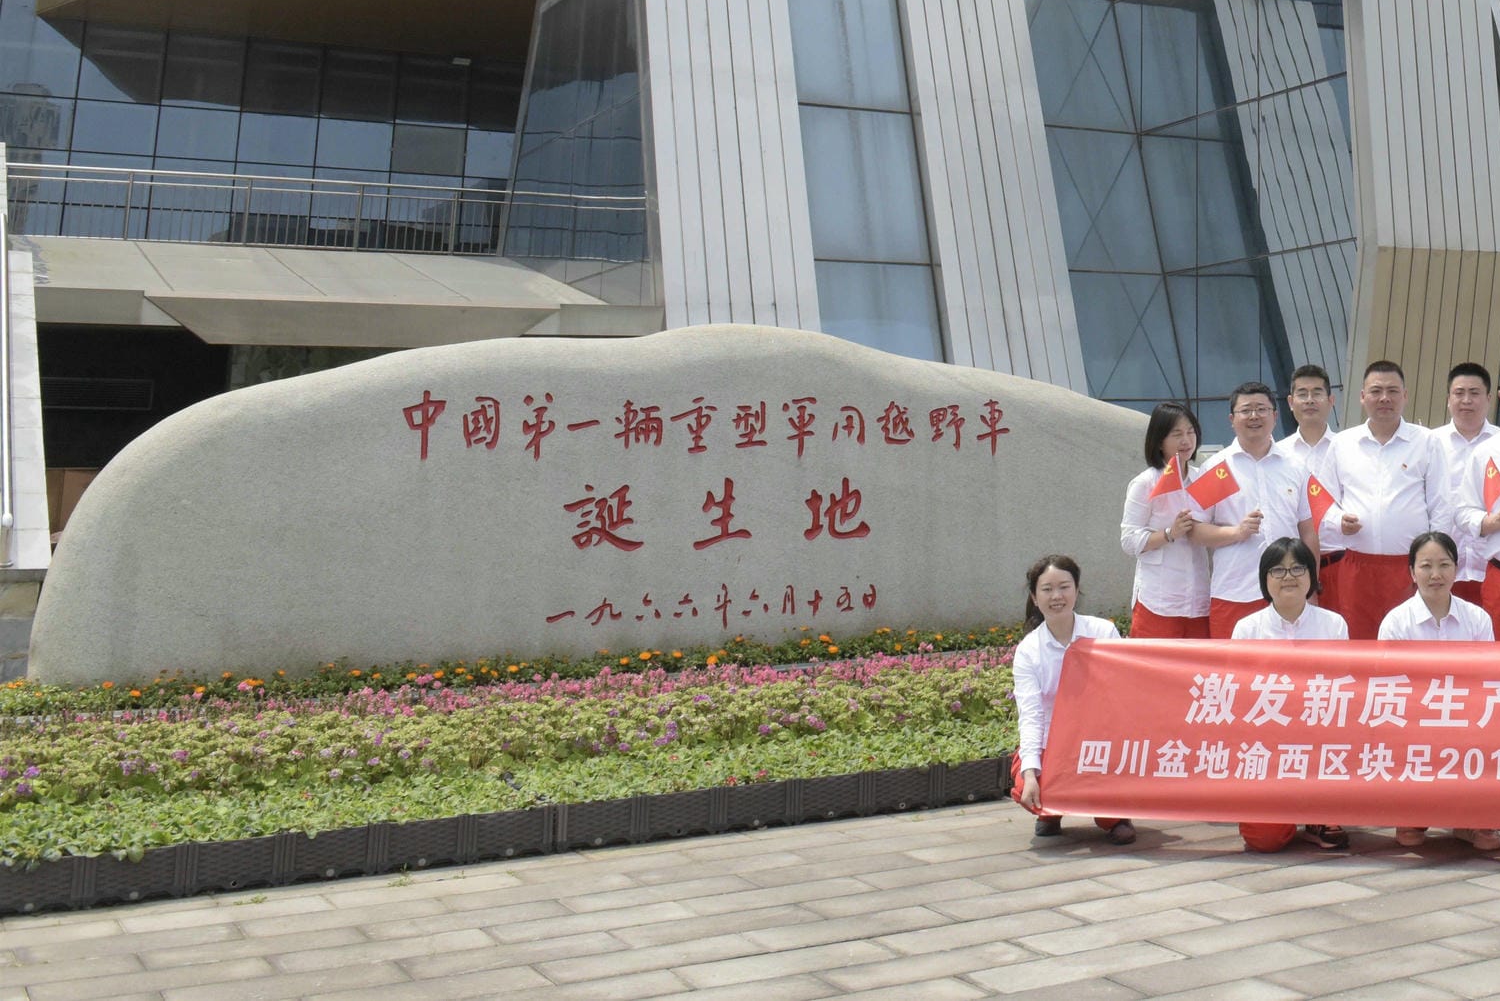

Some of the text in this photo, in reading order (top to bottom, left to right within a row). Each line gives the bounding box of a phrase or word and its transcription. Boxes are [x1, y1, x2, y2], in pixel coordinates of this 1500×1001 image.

[546, 583, 878, 629] 一九六六年六月十五日
